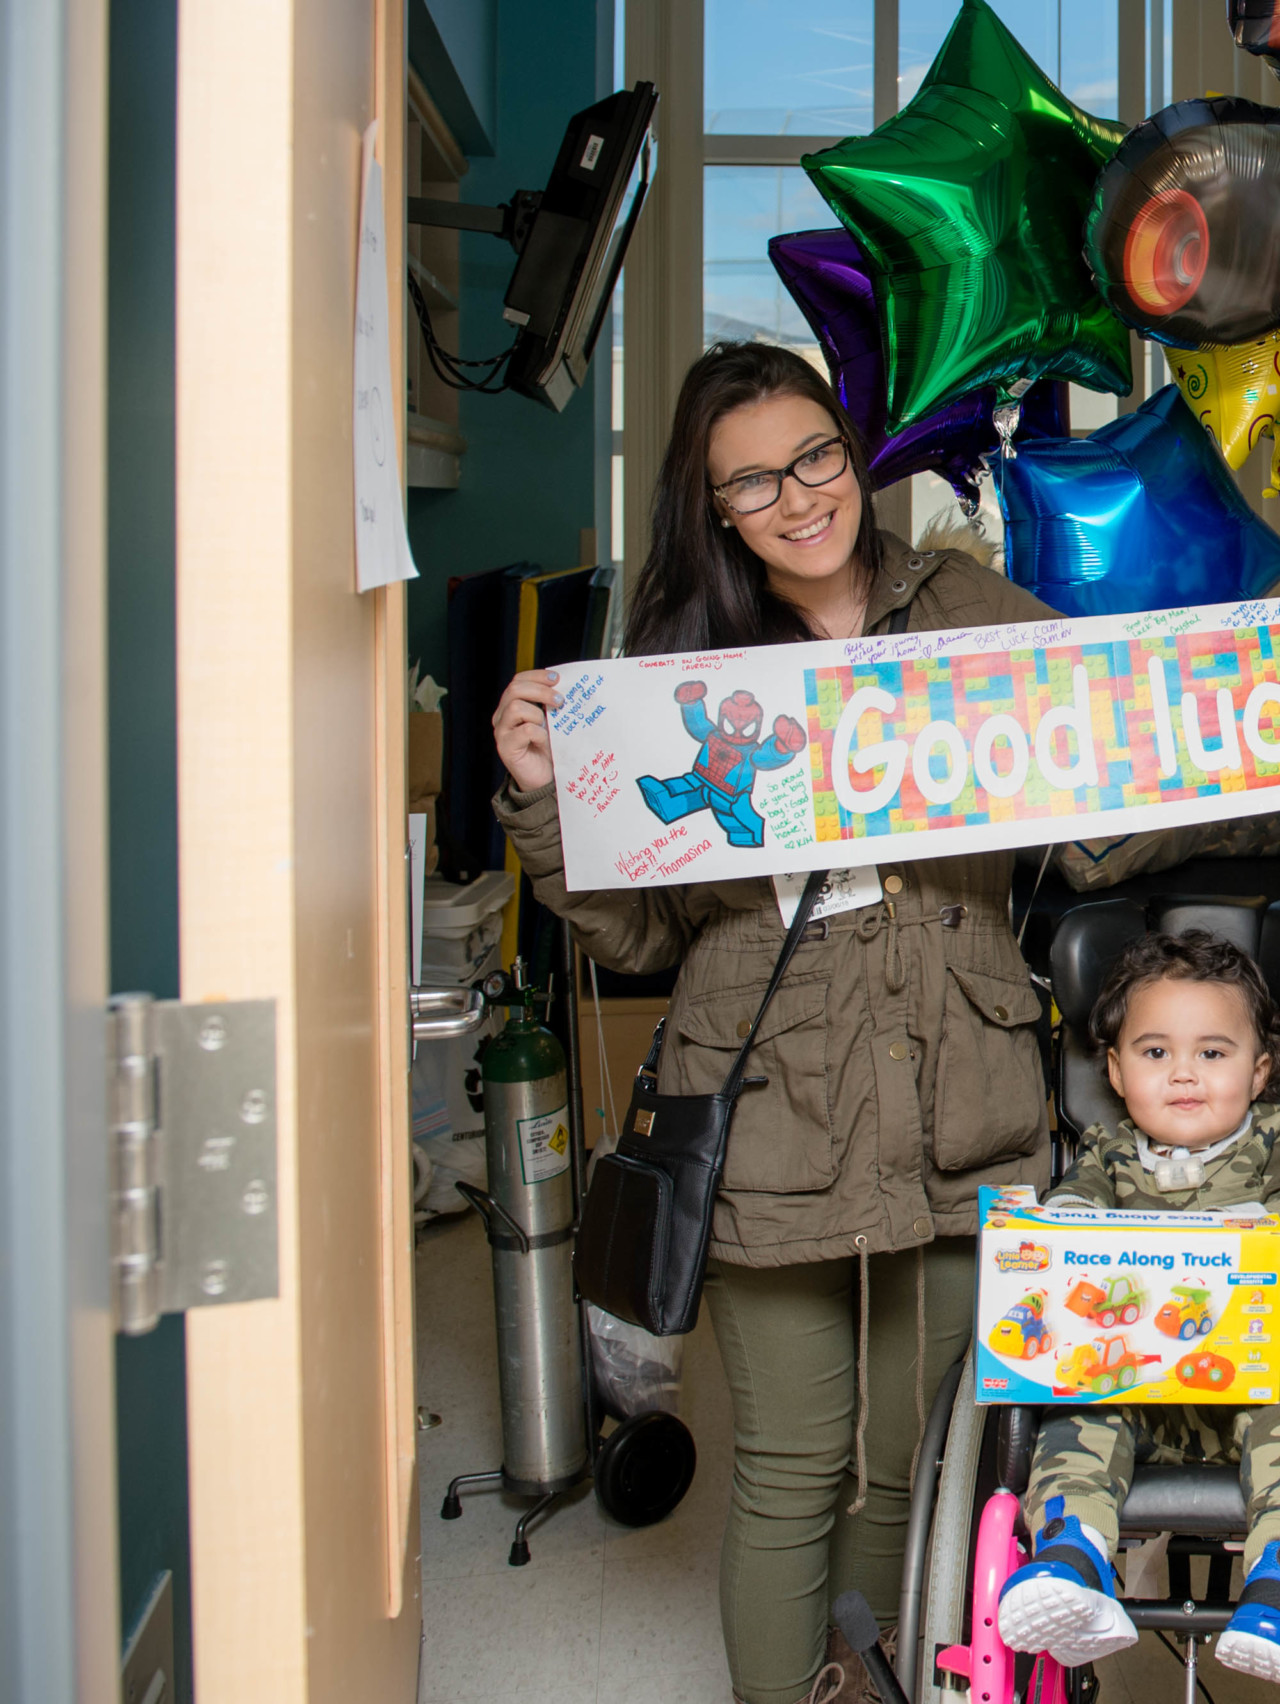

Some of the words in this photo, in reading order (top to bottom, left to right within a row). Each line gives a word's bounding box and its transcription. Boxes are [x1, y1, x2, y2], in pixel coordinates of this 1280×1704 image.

[831, 664, 1099, 814] Good
[614, 847, 653, 875] Wishing
[651, 837, 669, 853] you
[669, 826, 688, 841] the
[1064, 1251, 1111, 1266] Race
[1118, 1251, 1174, 1270] Along
[1181, 1252, 1232, 1267] Truck
